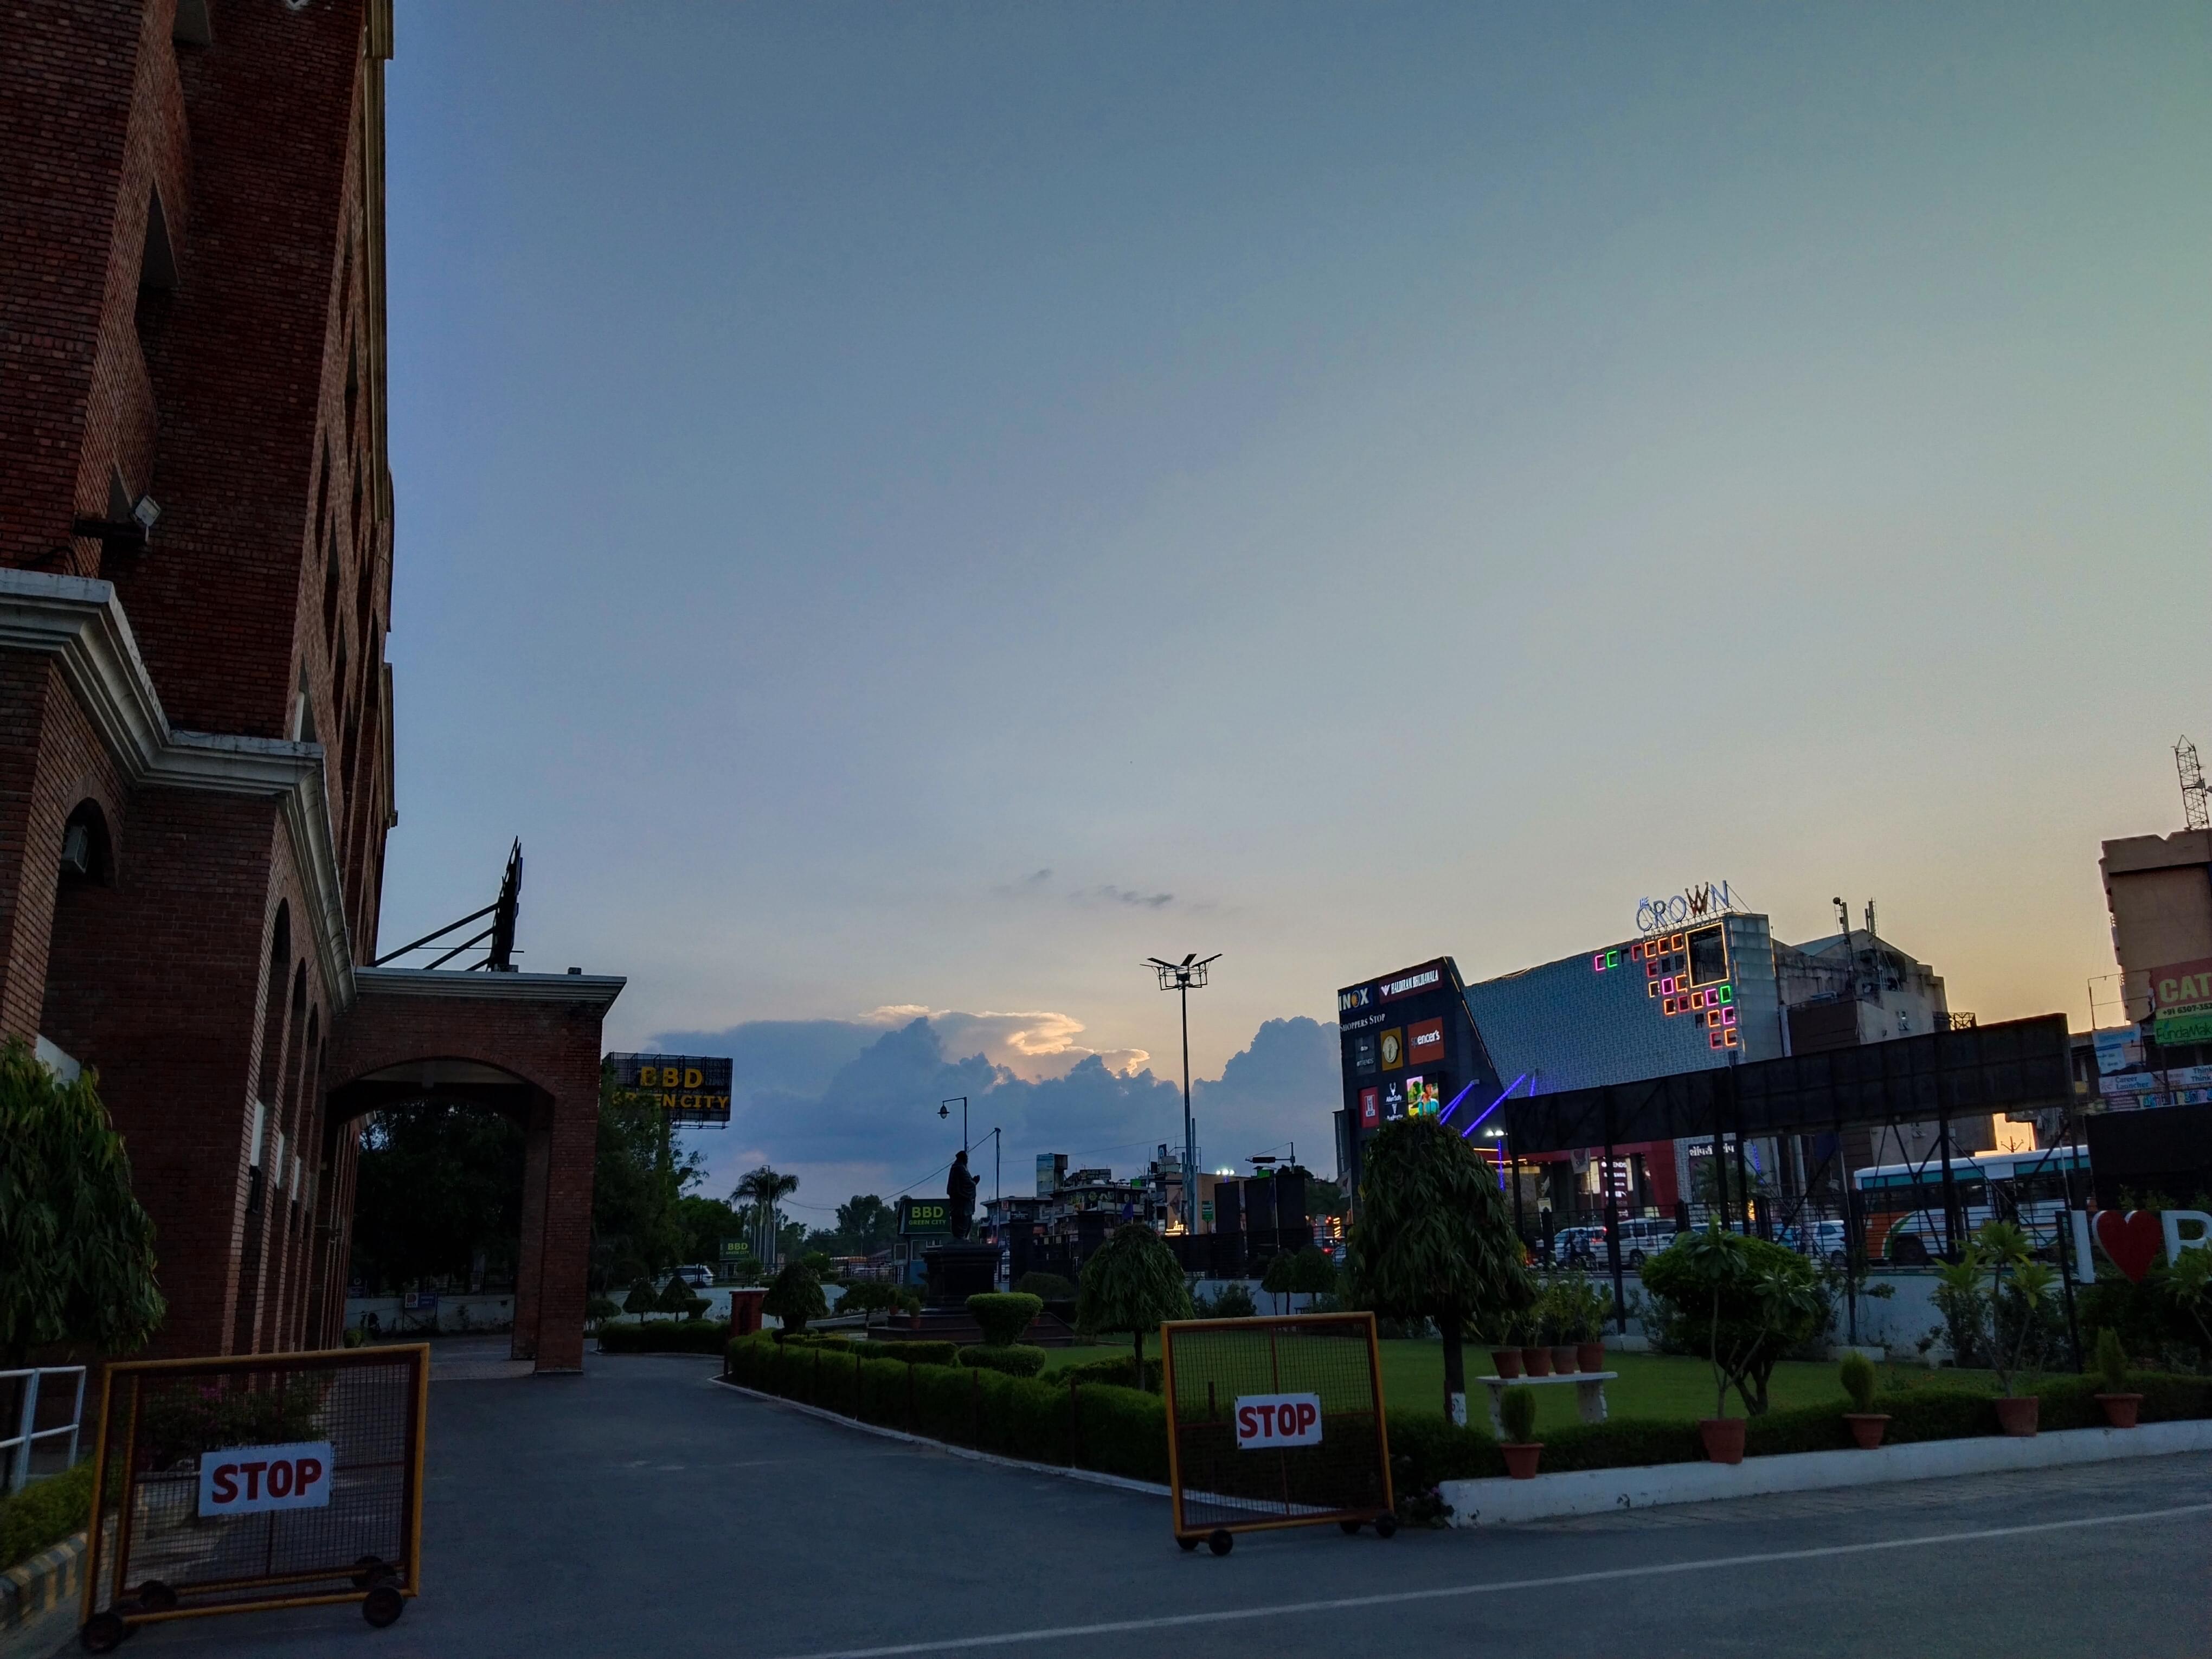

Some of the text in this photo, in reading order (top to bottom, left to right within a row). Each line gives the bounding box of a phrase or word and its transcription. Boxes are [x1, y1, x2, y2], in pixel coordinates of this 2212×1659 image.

[1636, 880, 1729, 931] CROWN
[1339, 987, 1370, 1012] INOX
[1411, 1030, 1441, 1047] spencer's
[640, 1066, 704, 1089] BBD
[680, 1094, 729, 1109] CITY
[912, 1206, 944, 1219] BBD
[728, 1242, 748, 1251] BBD
[1239, 1403, 1316, 1438] STOP
[212, 1458, 322, 1503] STOP
